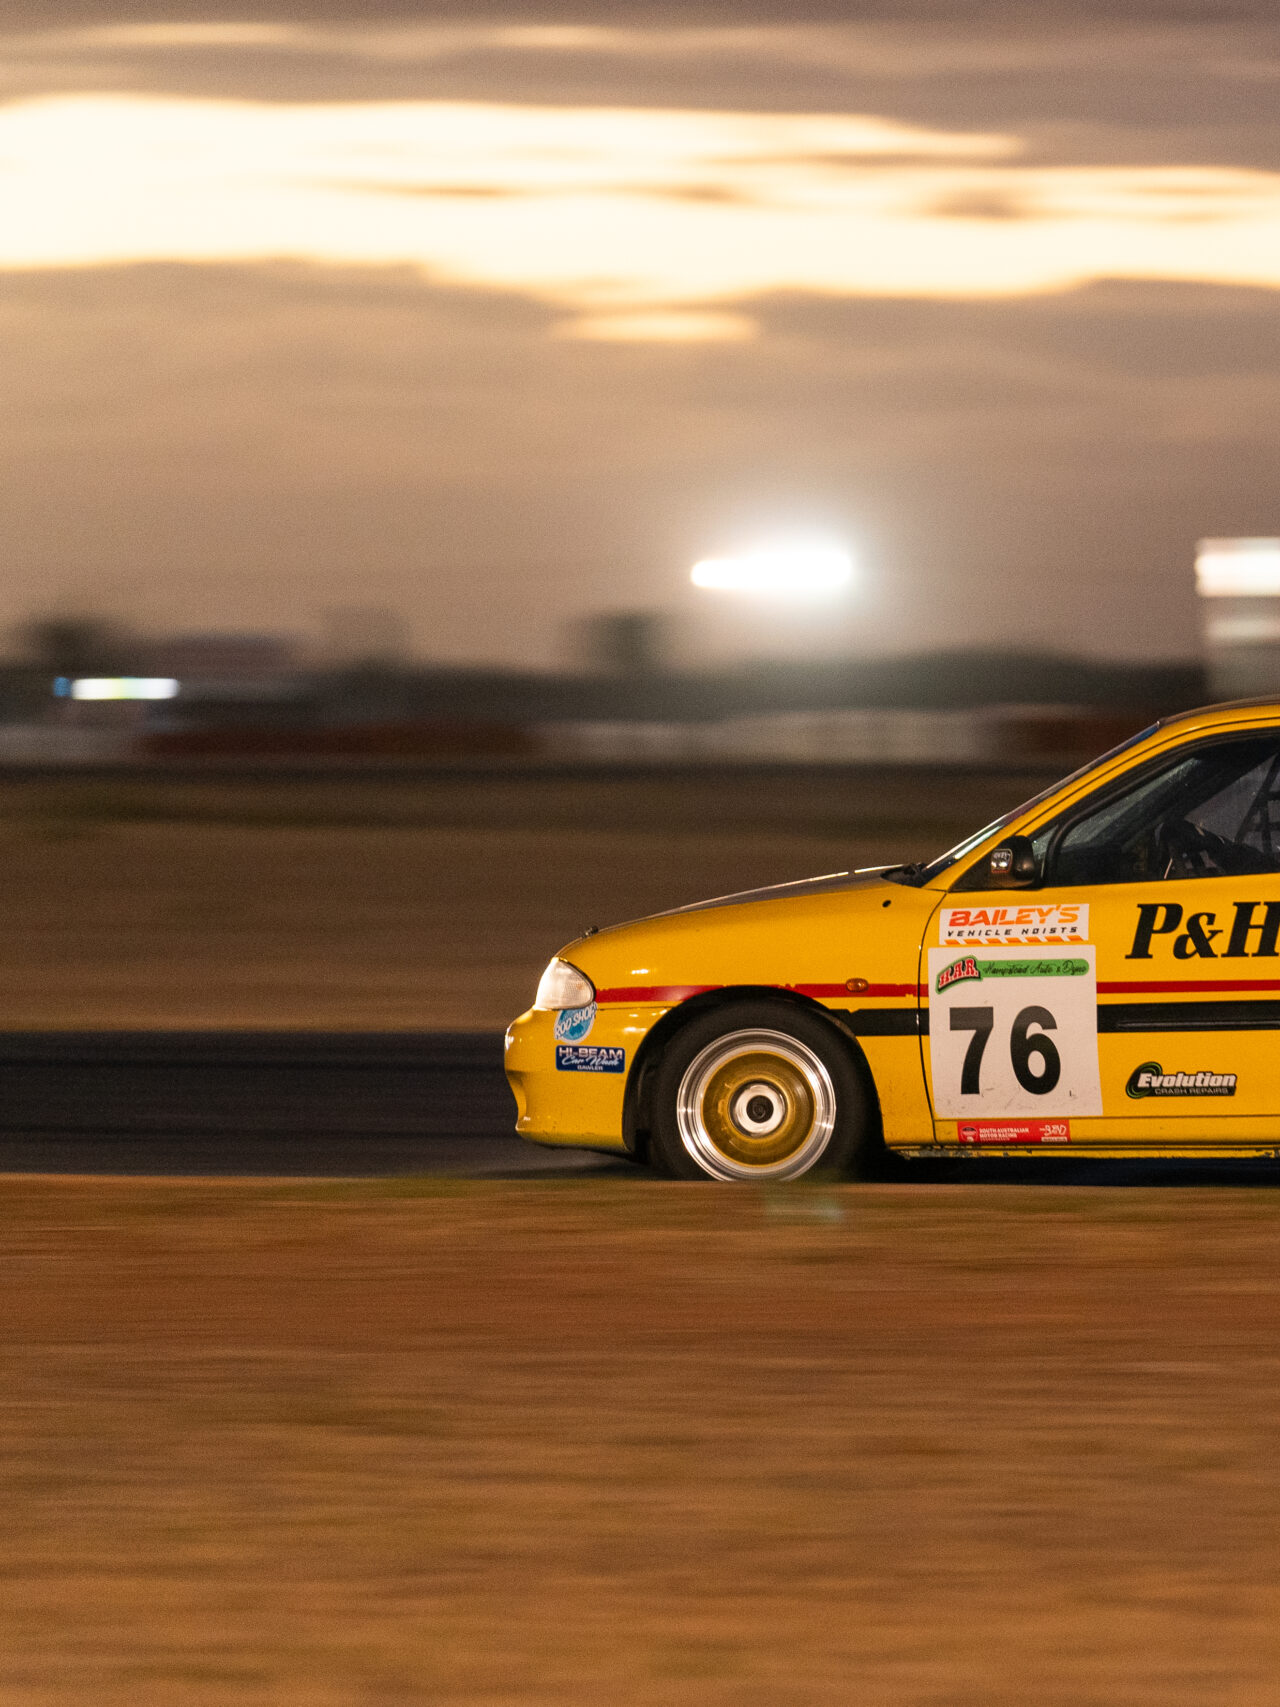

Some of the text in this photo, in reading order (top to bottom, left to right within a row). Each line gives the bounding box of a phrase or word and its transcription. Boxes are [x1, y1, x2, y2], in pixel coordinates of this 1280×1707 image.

[949, 904, 1081, 927] BAILEY'S
[947, 926, 1078, 937] VEHICLE HOISTS
[938, 957, 979, 988] H.A.R.
[559, 1047, 623, 1059] HI-BEAM
[949, 1005, 1061, 1095] 76
[1137, 1072, 1236, 1087] Evolution
[1155, 1087, 1229, 1095] CRASH REPAIRS
